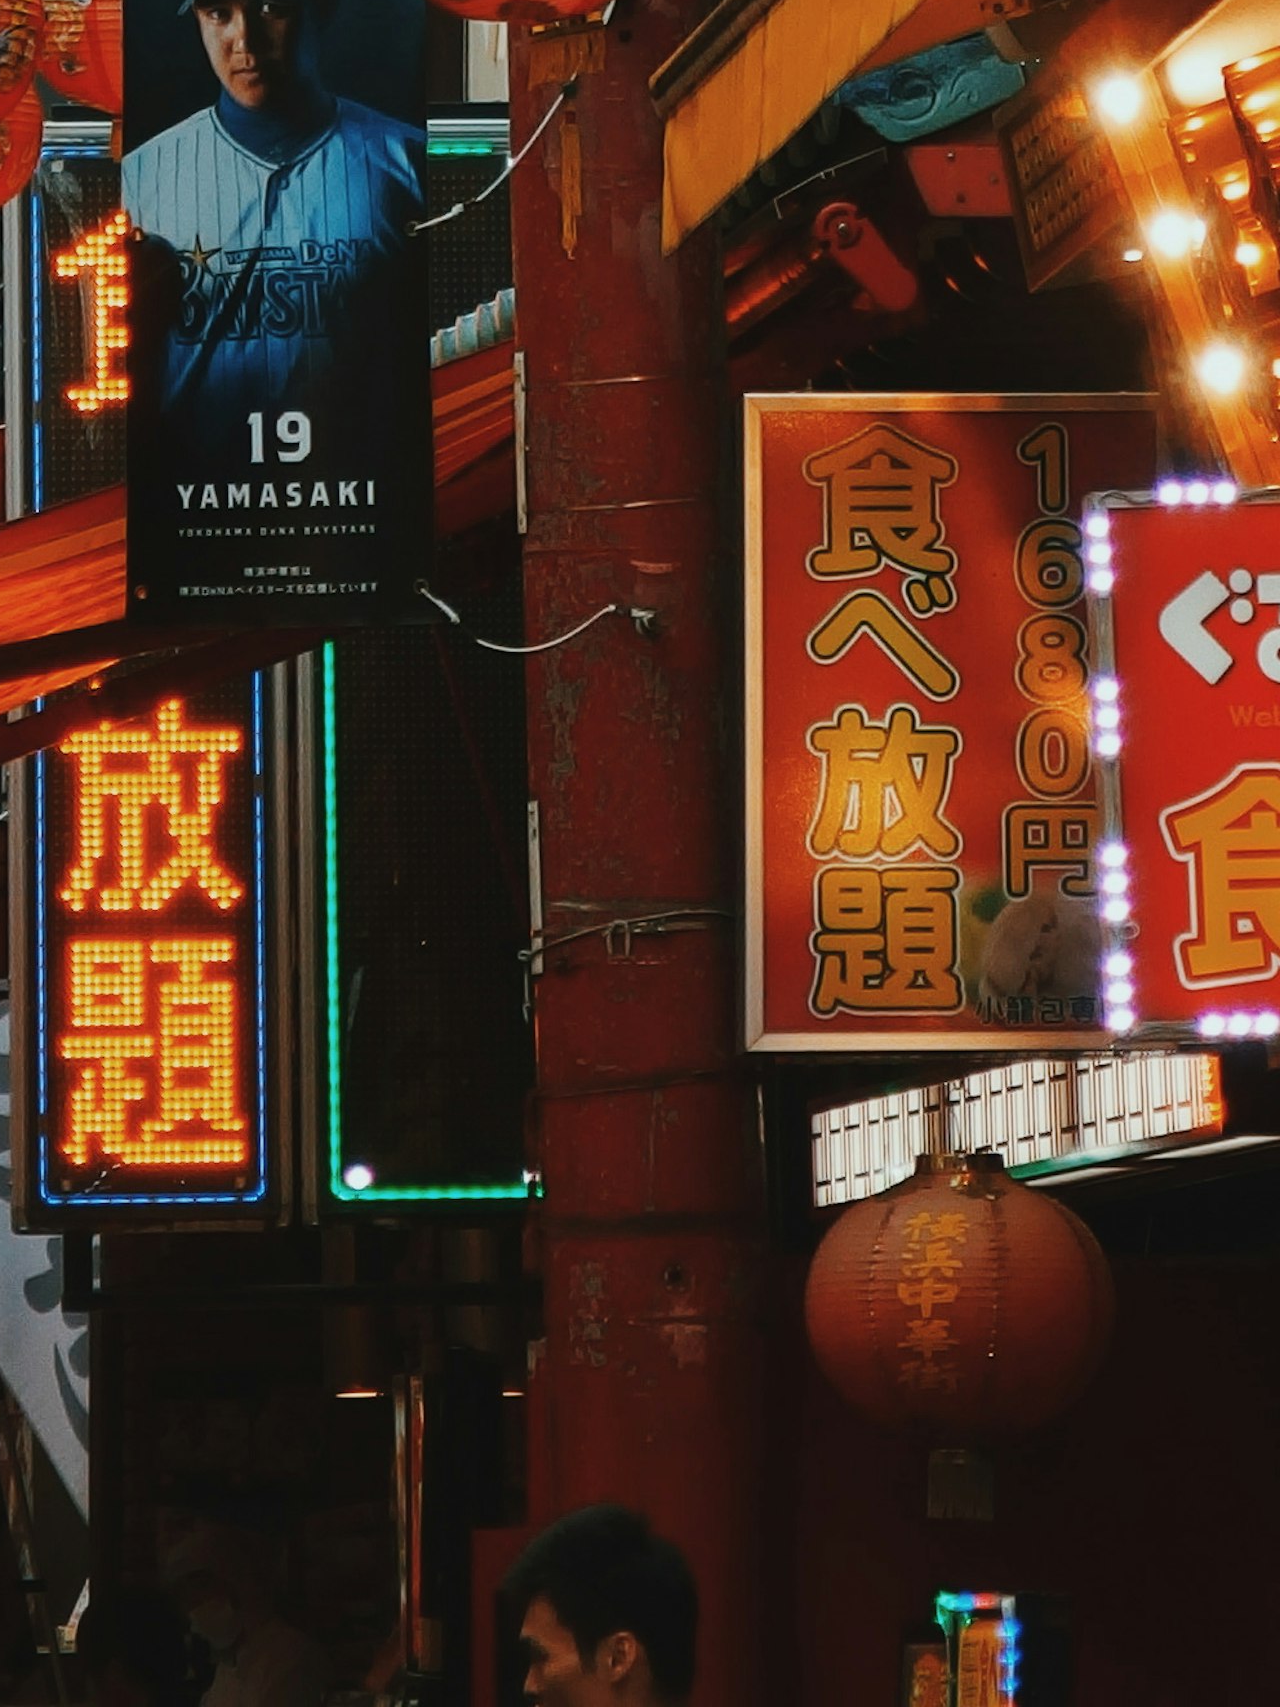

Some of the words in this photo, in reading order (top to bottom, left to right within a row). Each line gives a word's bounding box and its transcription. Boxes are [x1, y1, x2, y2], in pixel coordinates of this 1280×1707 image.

[177, 480, 376, 509] YAMASAKI
[179, 527, 252, 537] YOKOHAMA
[304, 524, 376, 536] BAYSTARS
[246, 411, 314, 464] 19
[805, 423, 963, 1017] 食べ放題
[1003, 423, 1098, 900] 1680円
[58, 697, 244, 1166] 放題
